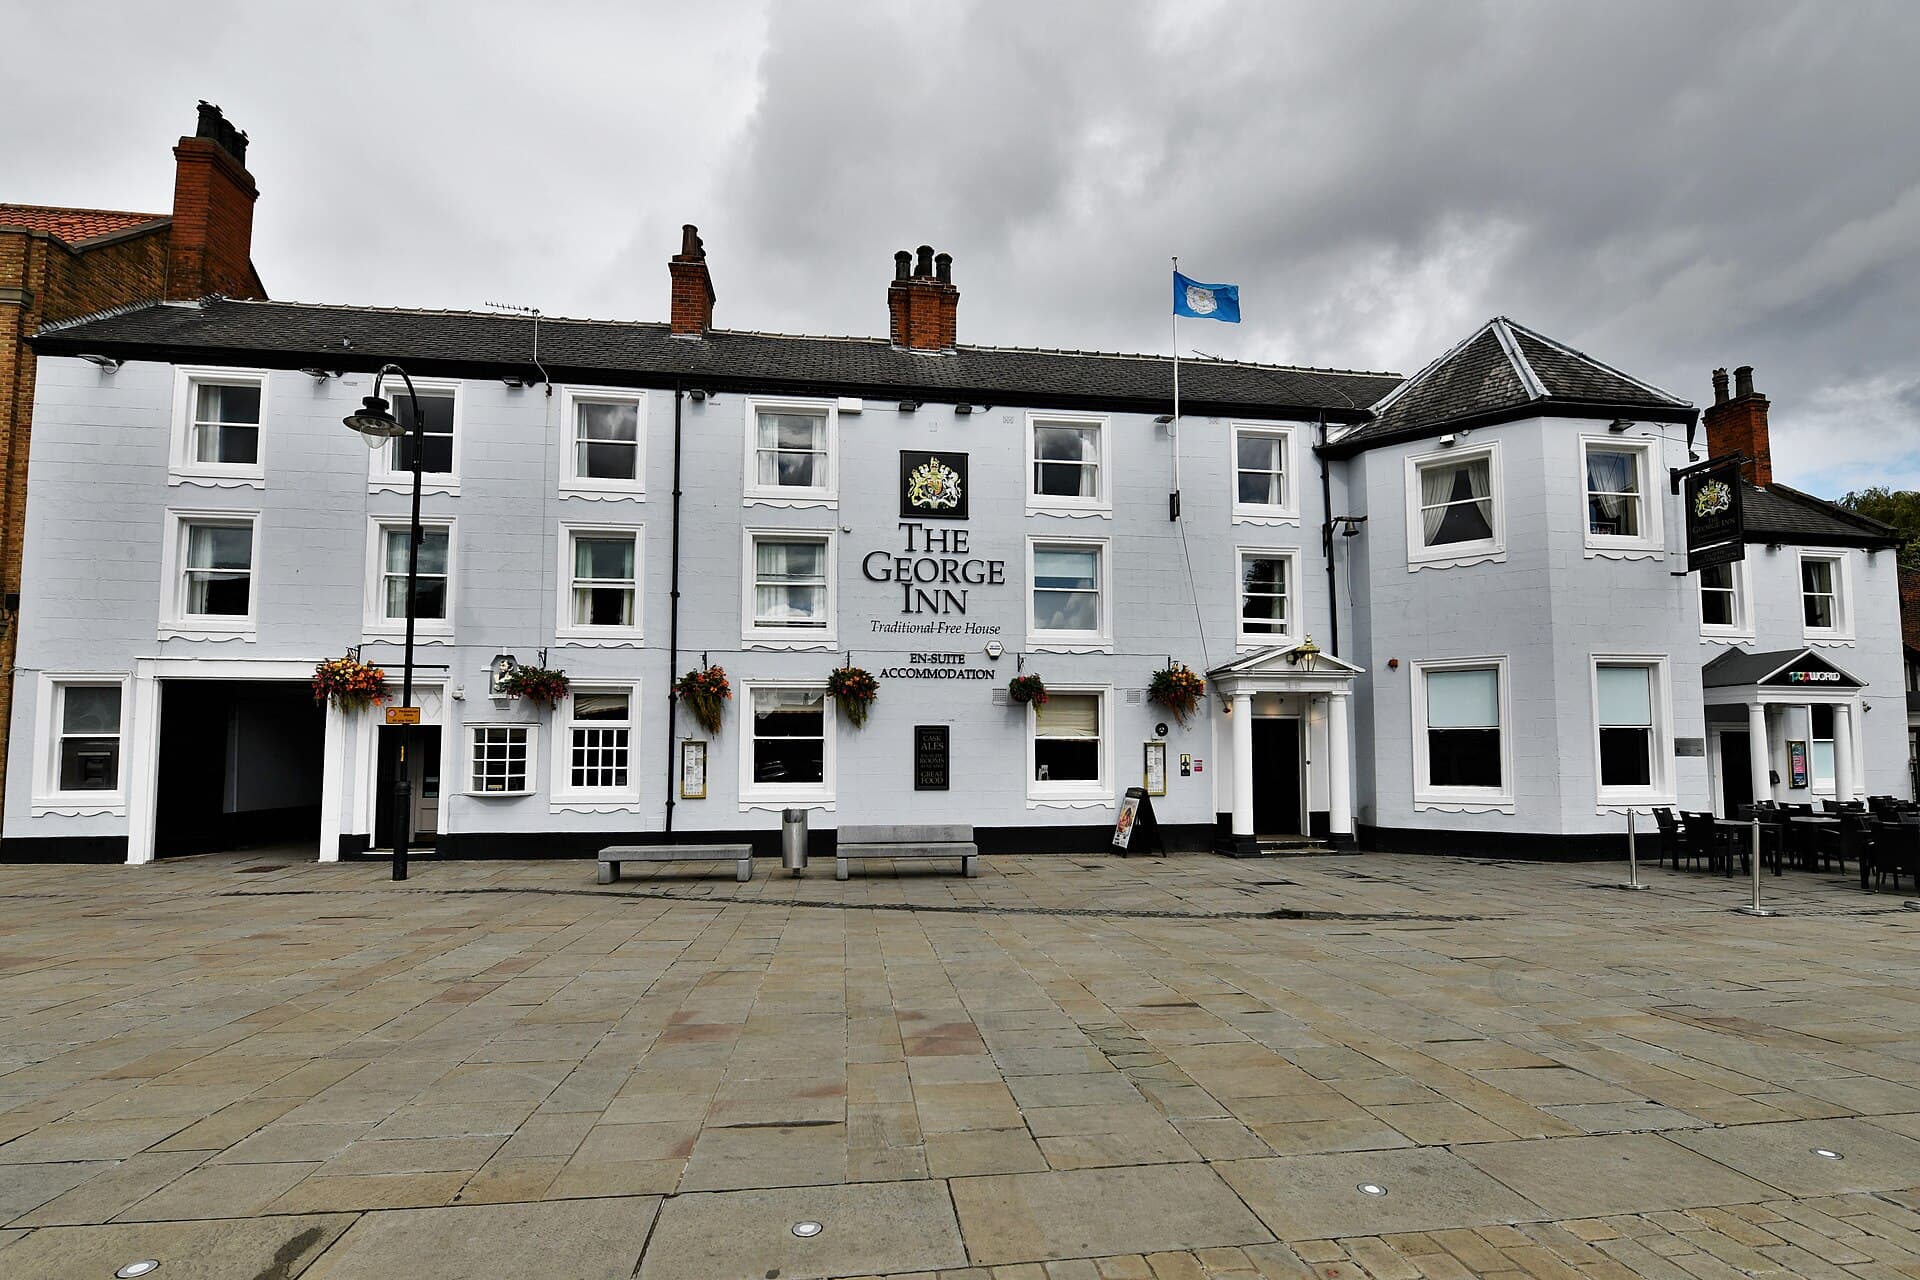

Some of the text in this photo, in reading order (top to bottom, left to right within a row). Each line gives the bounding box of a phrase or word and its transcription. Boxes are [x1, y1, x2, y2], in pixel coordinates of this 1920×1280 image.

[899, 523, 970, 553] THE
[862, 551, 1006, 584] GEORGE
[901, 583, 969, 614] INN
[870, 620, 1000, 635] Traditional Free House
[910, 653, 966, 664] EN-SUITE
[880, 667, 996, 680] ACCOMMODATION
[920, 742, 944, 751] ALES
